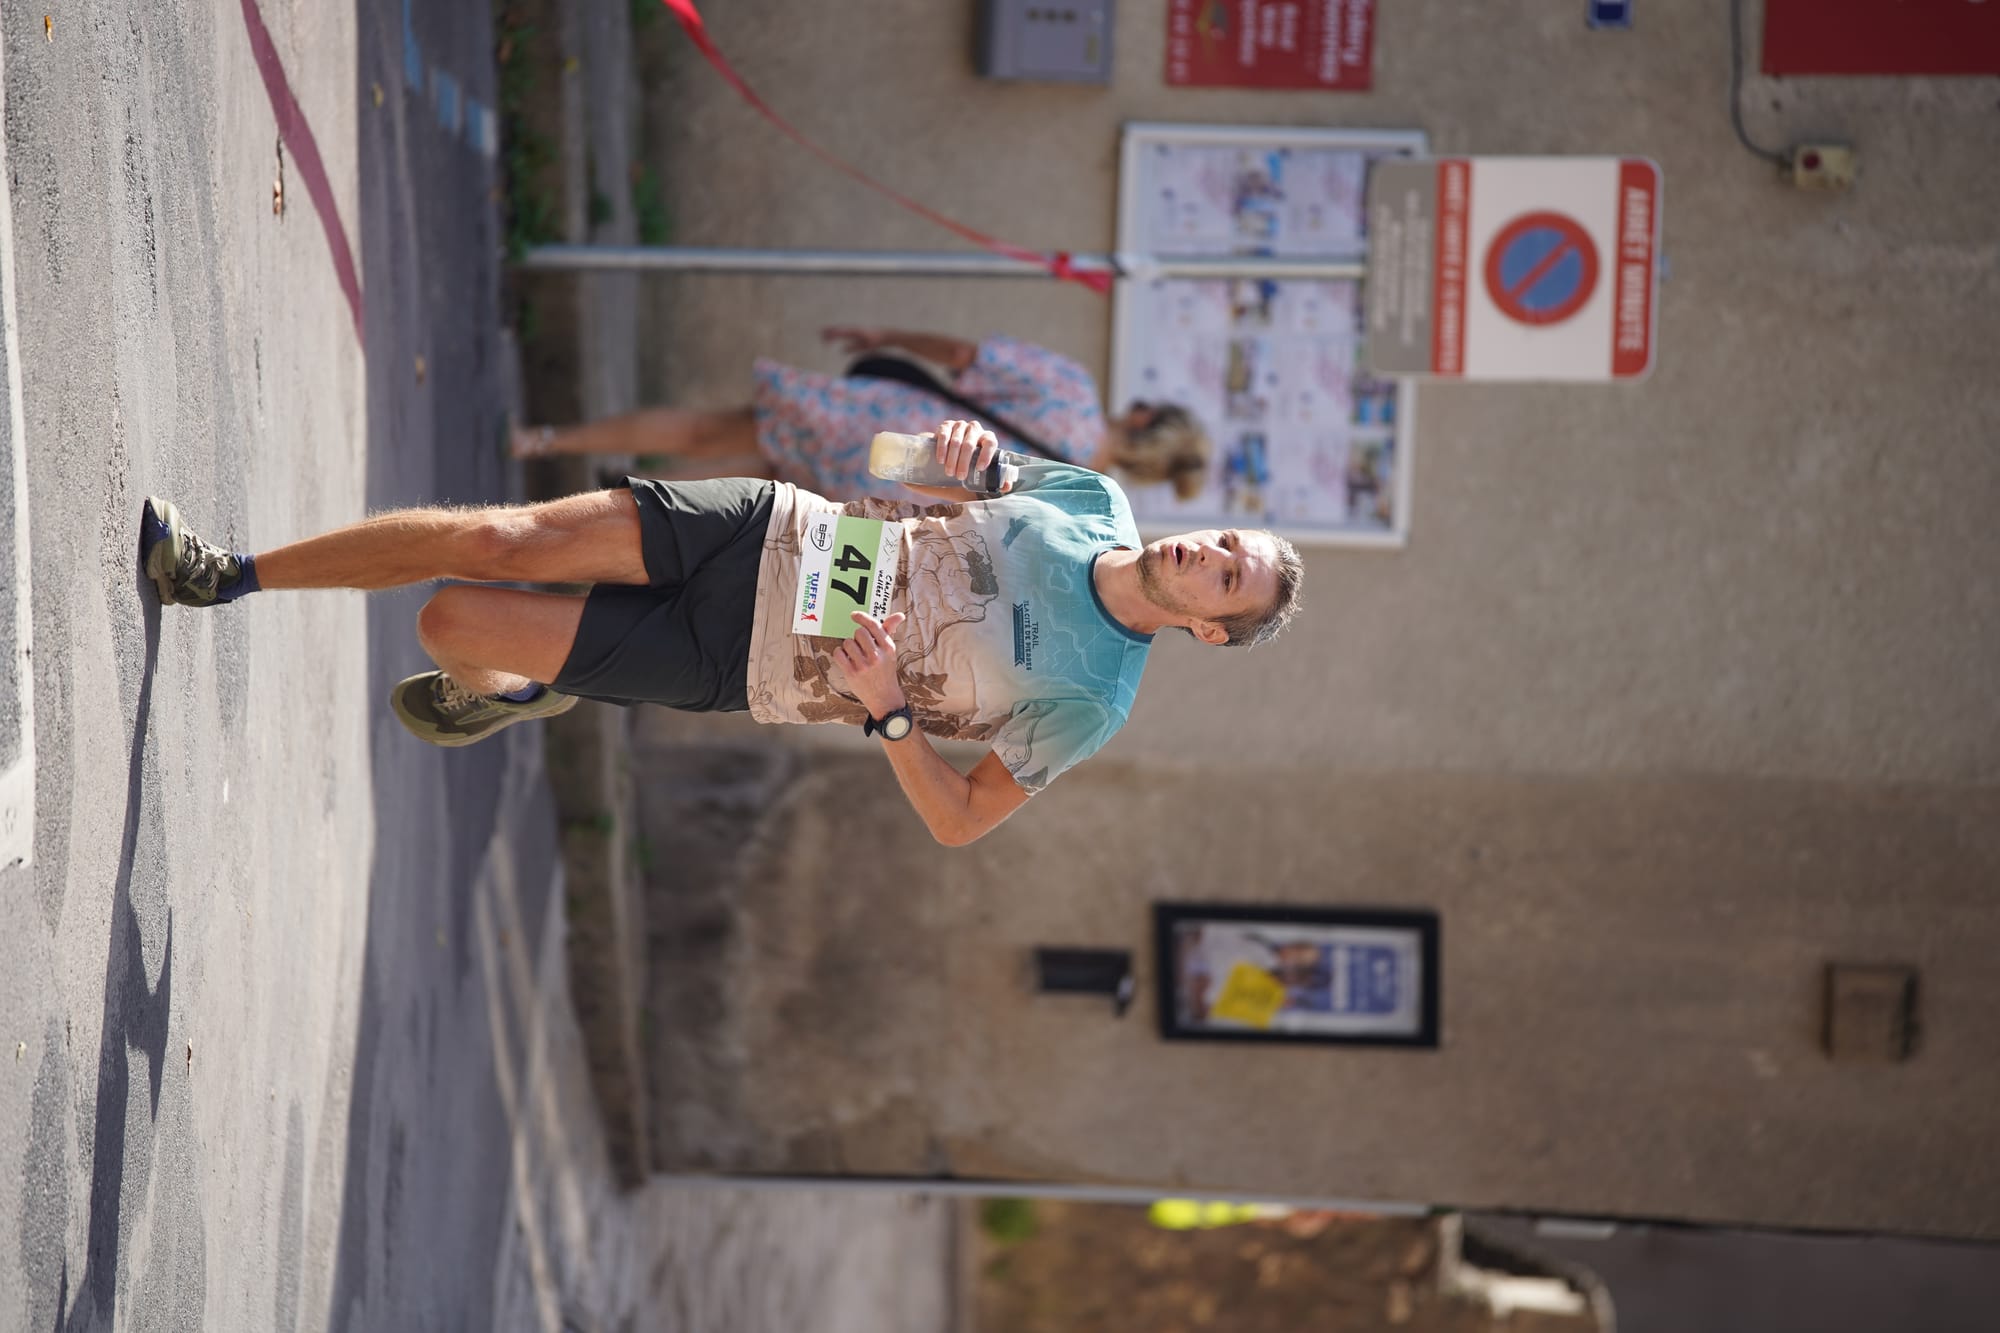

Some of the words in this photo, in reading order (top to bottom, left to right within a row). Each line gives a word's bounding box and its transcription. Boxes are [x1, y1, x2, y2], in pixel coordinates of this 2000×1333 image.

[817, 524, 828, 547] BFP
[802, 574, 813, 613] Aventure
[808, 572, 820, 610] TUFF'S
[830, 545, 871, 605] 47
[880, 575, 892, 615] Challenge
[1025, 631, 1031, 640] DE
